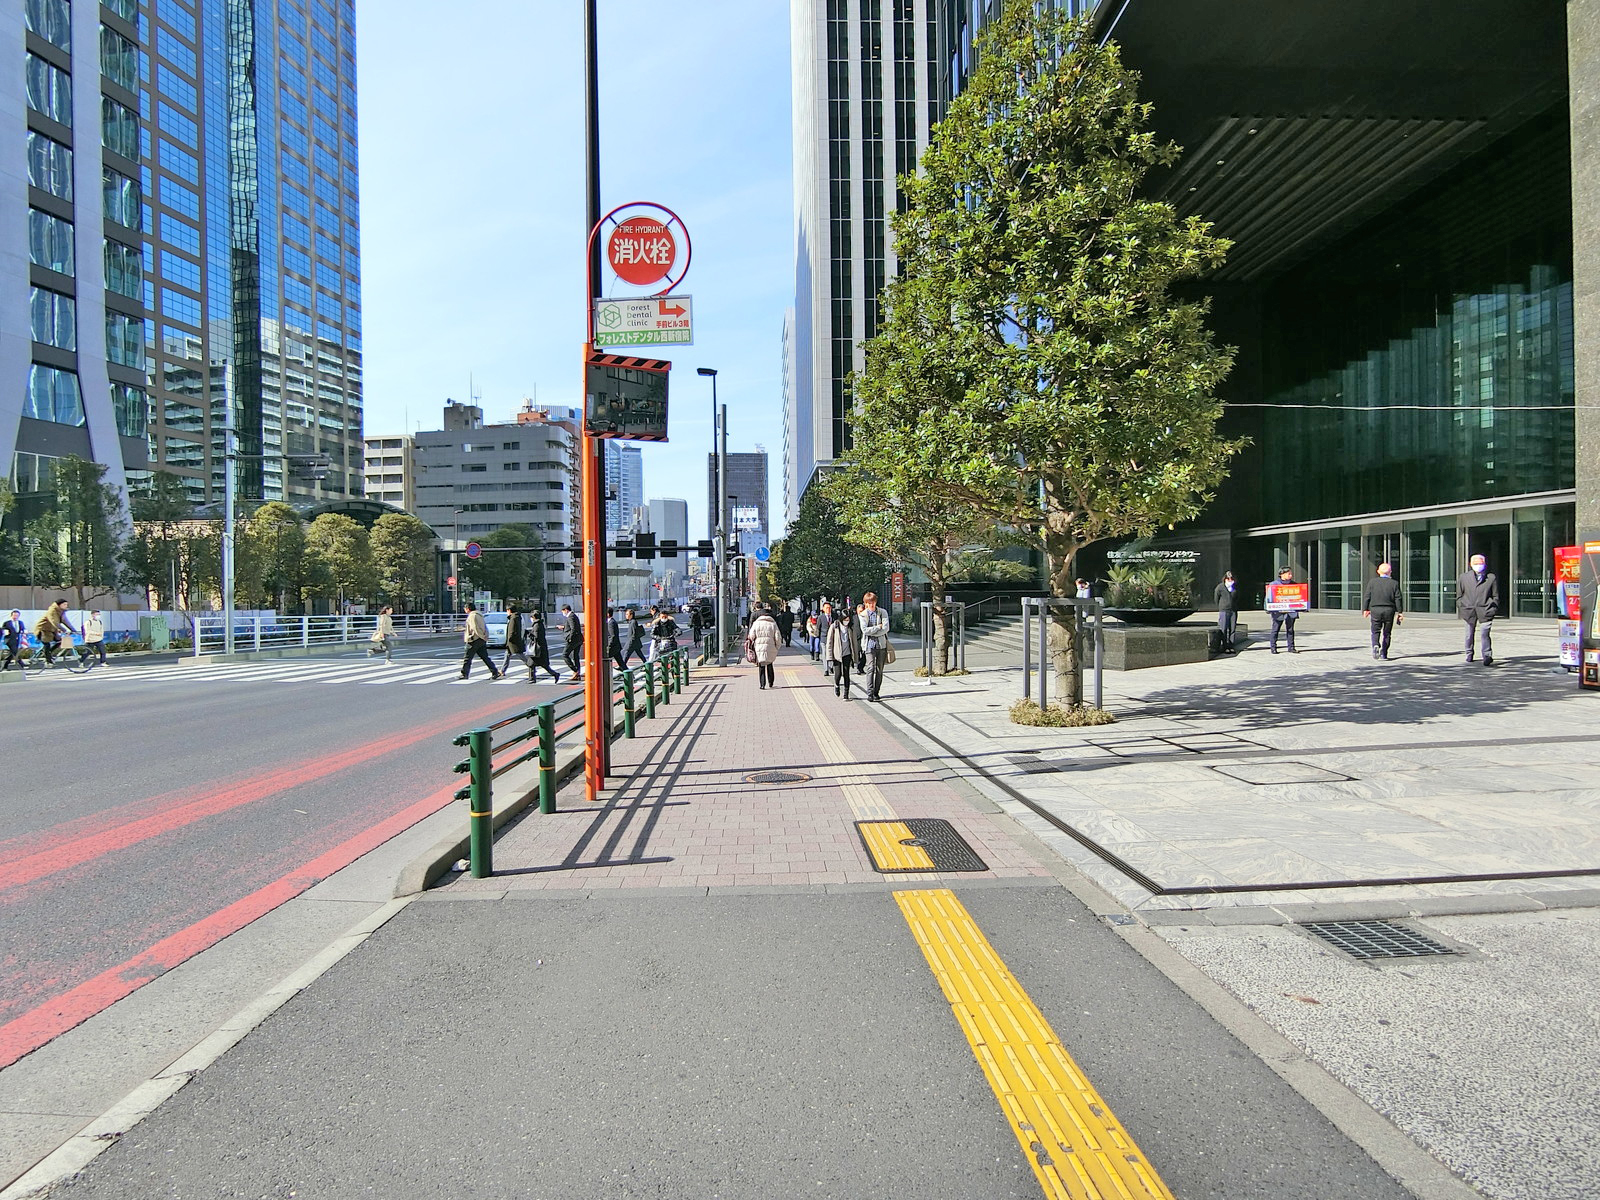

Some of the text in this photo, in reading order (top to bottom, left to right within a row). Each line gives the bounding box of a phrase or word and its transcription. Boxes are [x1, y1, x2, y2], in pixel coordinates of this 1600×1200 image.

[619, 225, 665, 234] FIRE HYDRANT
[613, 237, 671, 264] 消火栓
[626, 319, 648, 327] Clinic
[656, 319, 689, 329] 手前ビル3階
[599, 330, 690, 345] フォレストデンタル西新宿院
